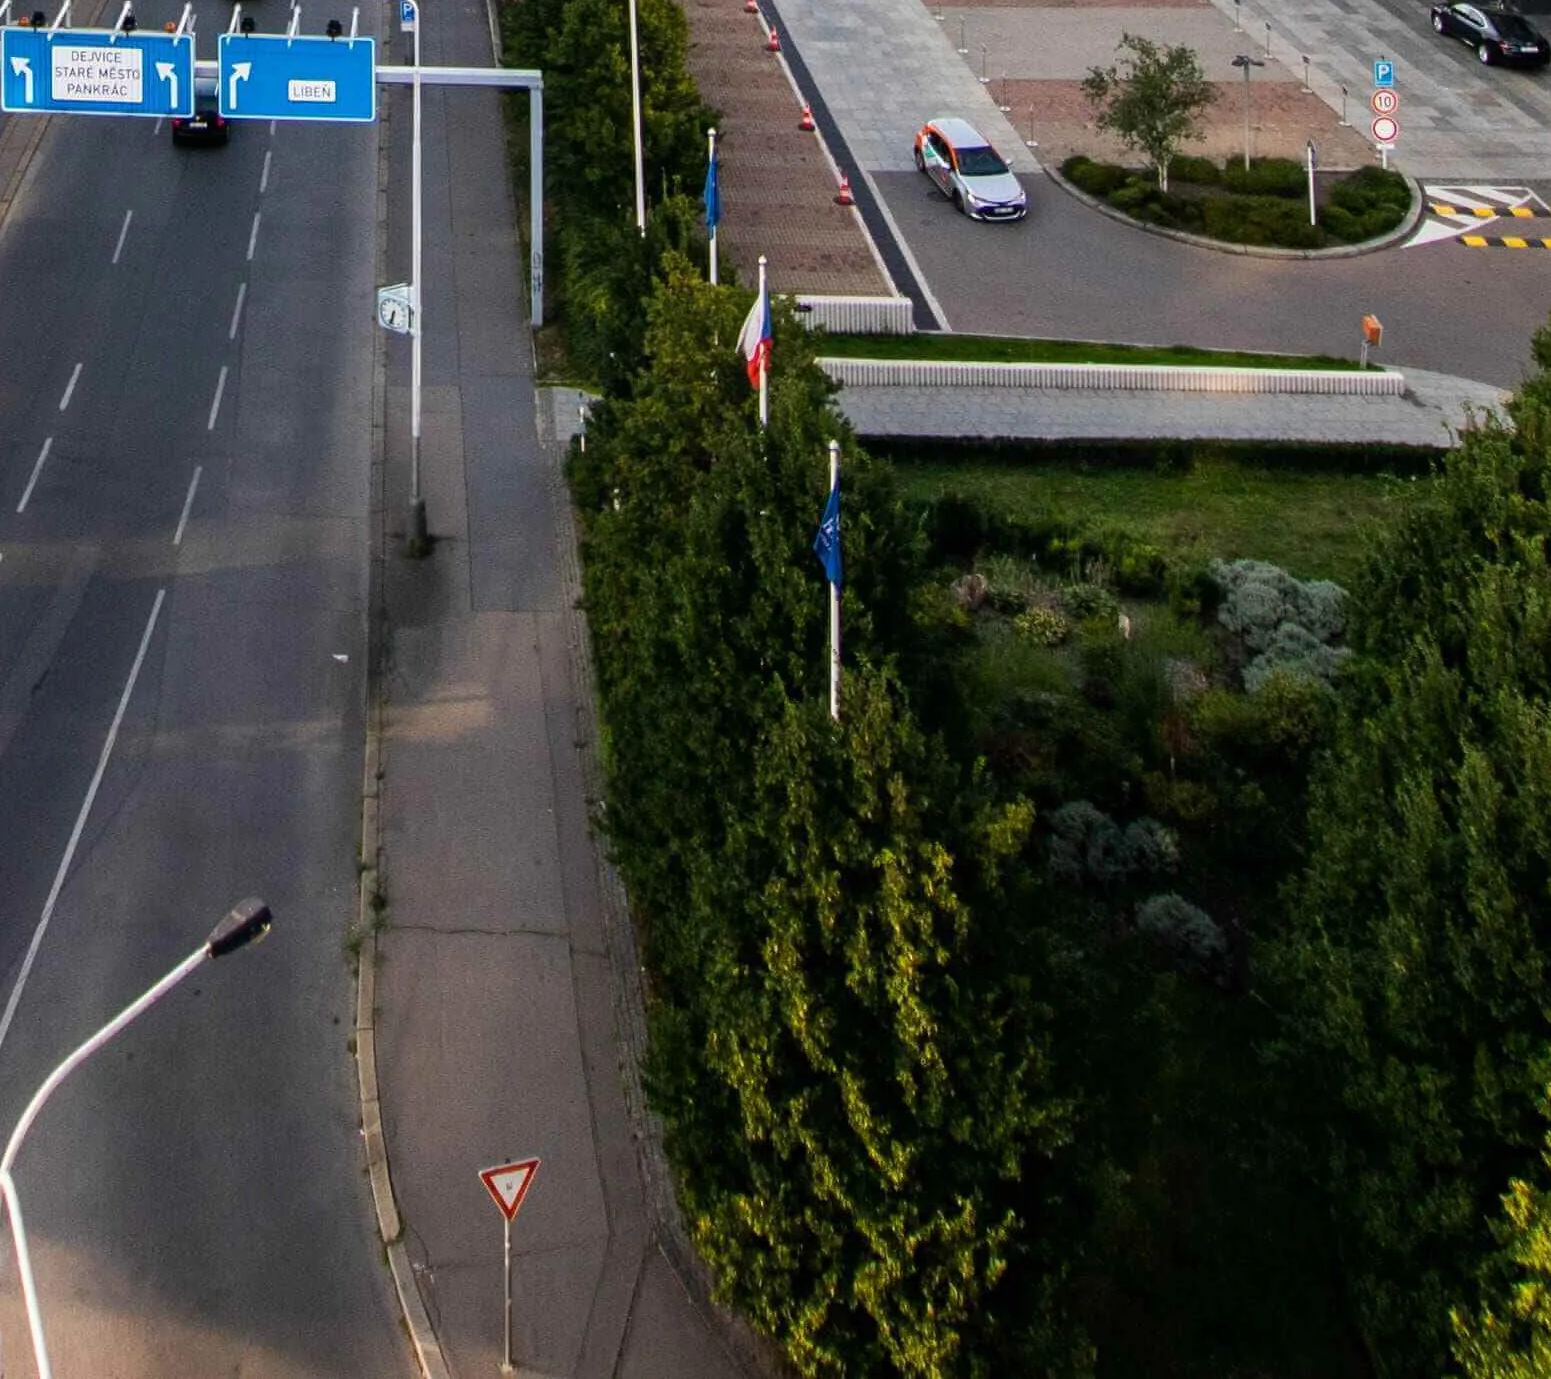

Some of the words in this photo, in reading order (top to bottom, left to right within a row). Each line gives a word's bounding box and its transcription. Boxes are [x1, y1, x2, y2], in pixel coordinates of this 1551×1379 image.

[403, 3, 414, 18] P
[71, 50, 122, 63] DEJVICE
[55, 64, 94, 79] STARÉ
[98, 66, 141, 81] MĚSTO
[1378, 64, 1390, 81] P
[67, 82, 128, 97] PANKRÁC
[293, 84, 331, 98] LIBEŇ
[1378, 96, 1392, 108] 10
